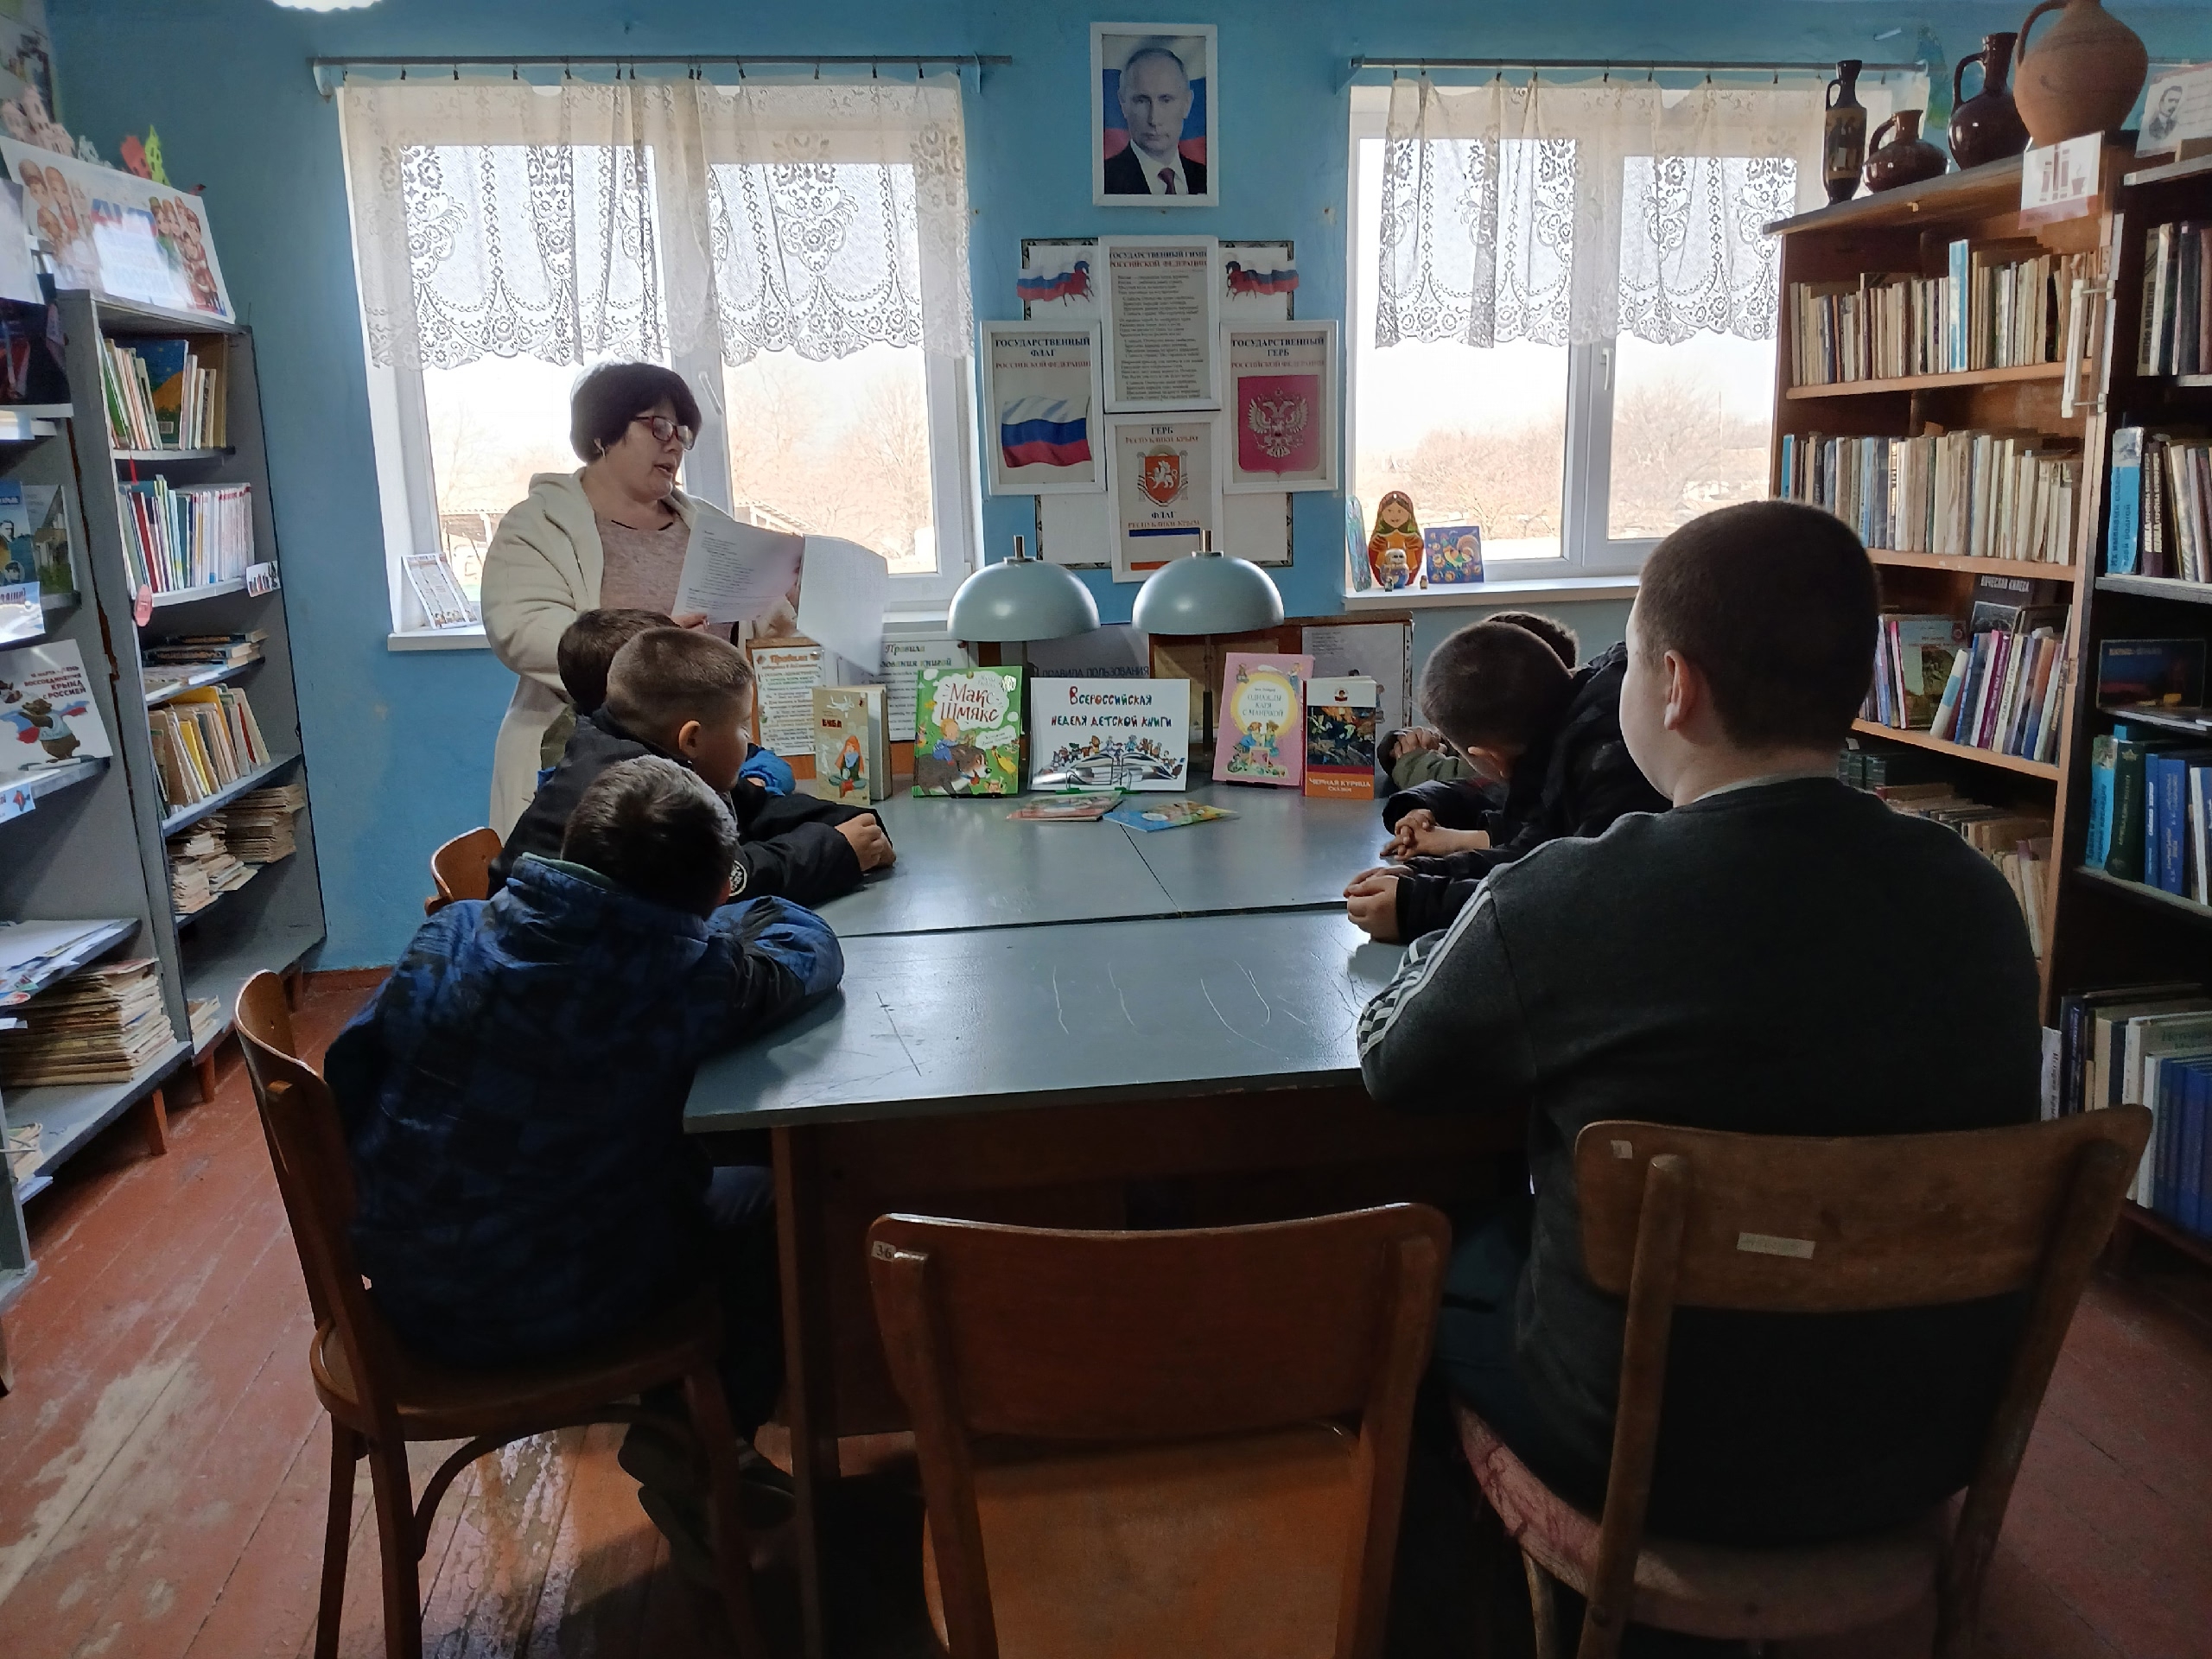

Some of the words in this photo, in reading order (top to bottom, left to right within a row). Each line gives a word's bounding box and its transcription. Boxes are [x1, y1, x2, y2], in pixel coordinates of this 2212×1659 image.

[995, 337, 1090, 347] ГОСУДАРСТВЕННЫЙ
[1232, 336, 1325, 347] ГОСУДАРСТВЕННЫЙ
[1268, 348, 1290, 357] ГЕРБ
[1151, 426, 1173, 435] ГЕРБ
[886, 644, 925, 656] Правила
[920, 658, 952, 668] книгой
[1042, 668, 1083, 677] ПРАВИЛА
[1086, 666, 1149, 677] ПОЛЬЗОВАНИЯ
[51, 680, 83, 690] КРЫМА
[48, 687, 86, 699] РОССИЕЙ
[950, 683, 995, 708] Макс
[941, 702, 999, 722] Шмякс
[877, 1244, 892, 1259] 36
